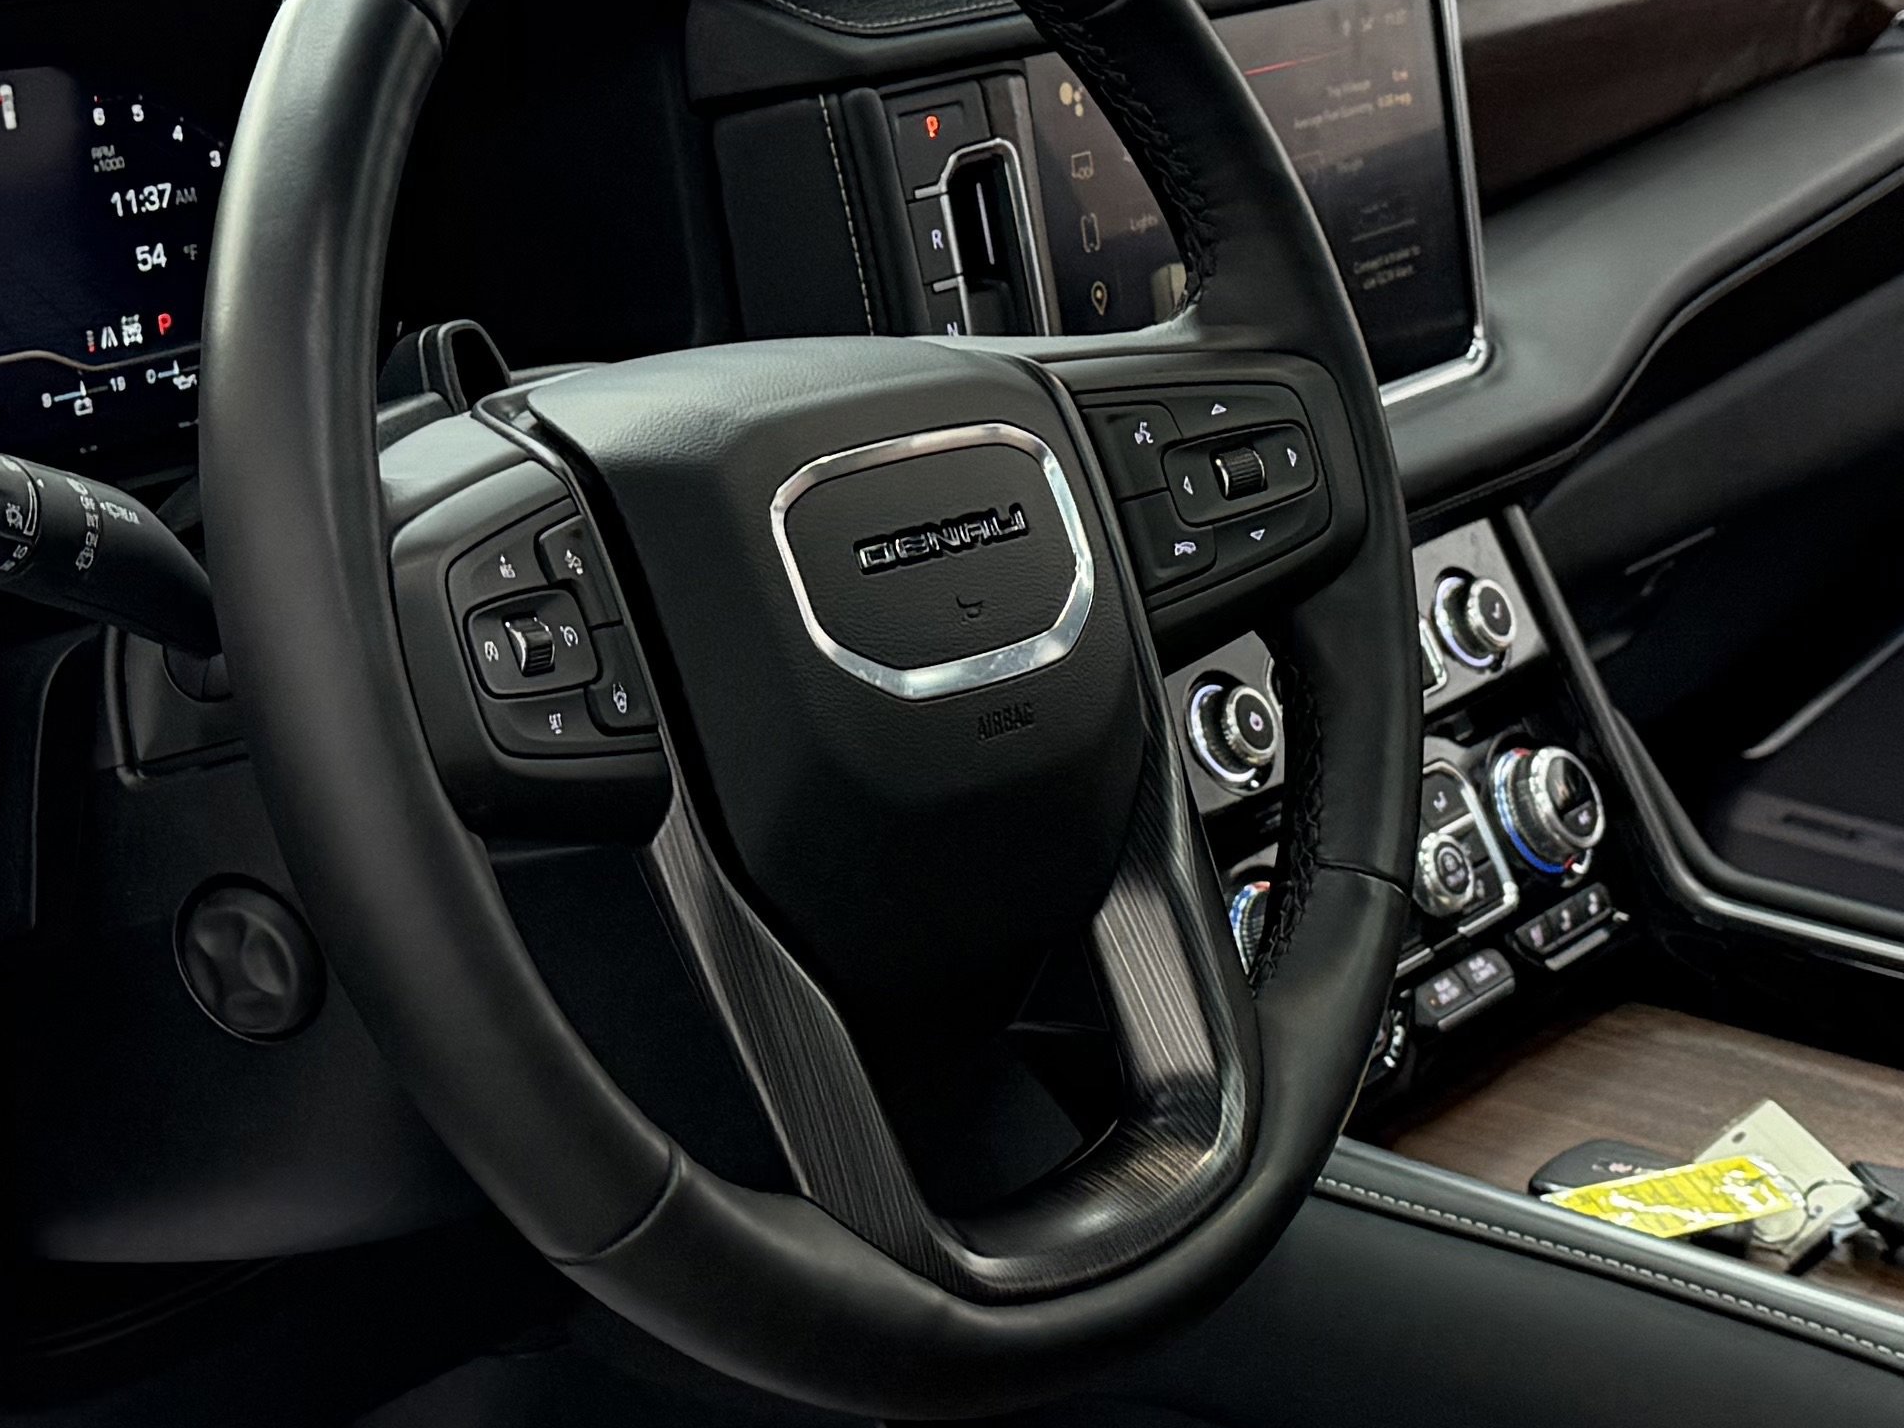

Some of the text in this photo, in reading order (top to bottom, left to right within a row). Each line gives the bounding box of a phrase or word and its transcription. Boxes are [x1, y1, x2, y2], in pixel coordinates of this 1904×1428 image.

[110, 182, 172, 217] 11:37
[931, 229, 943, 250] R
[135, 242, 167, 272] 54
[157, 313, 172, 336] P
[858, 510, 1027, 570] DENALI
[977, 702, 1036, 742] AIRBAG
